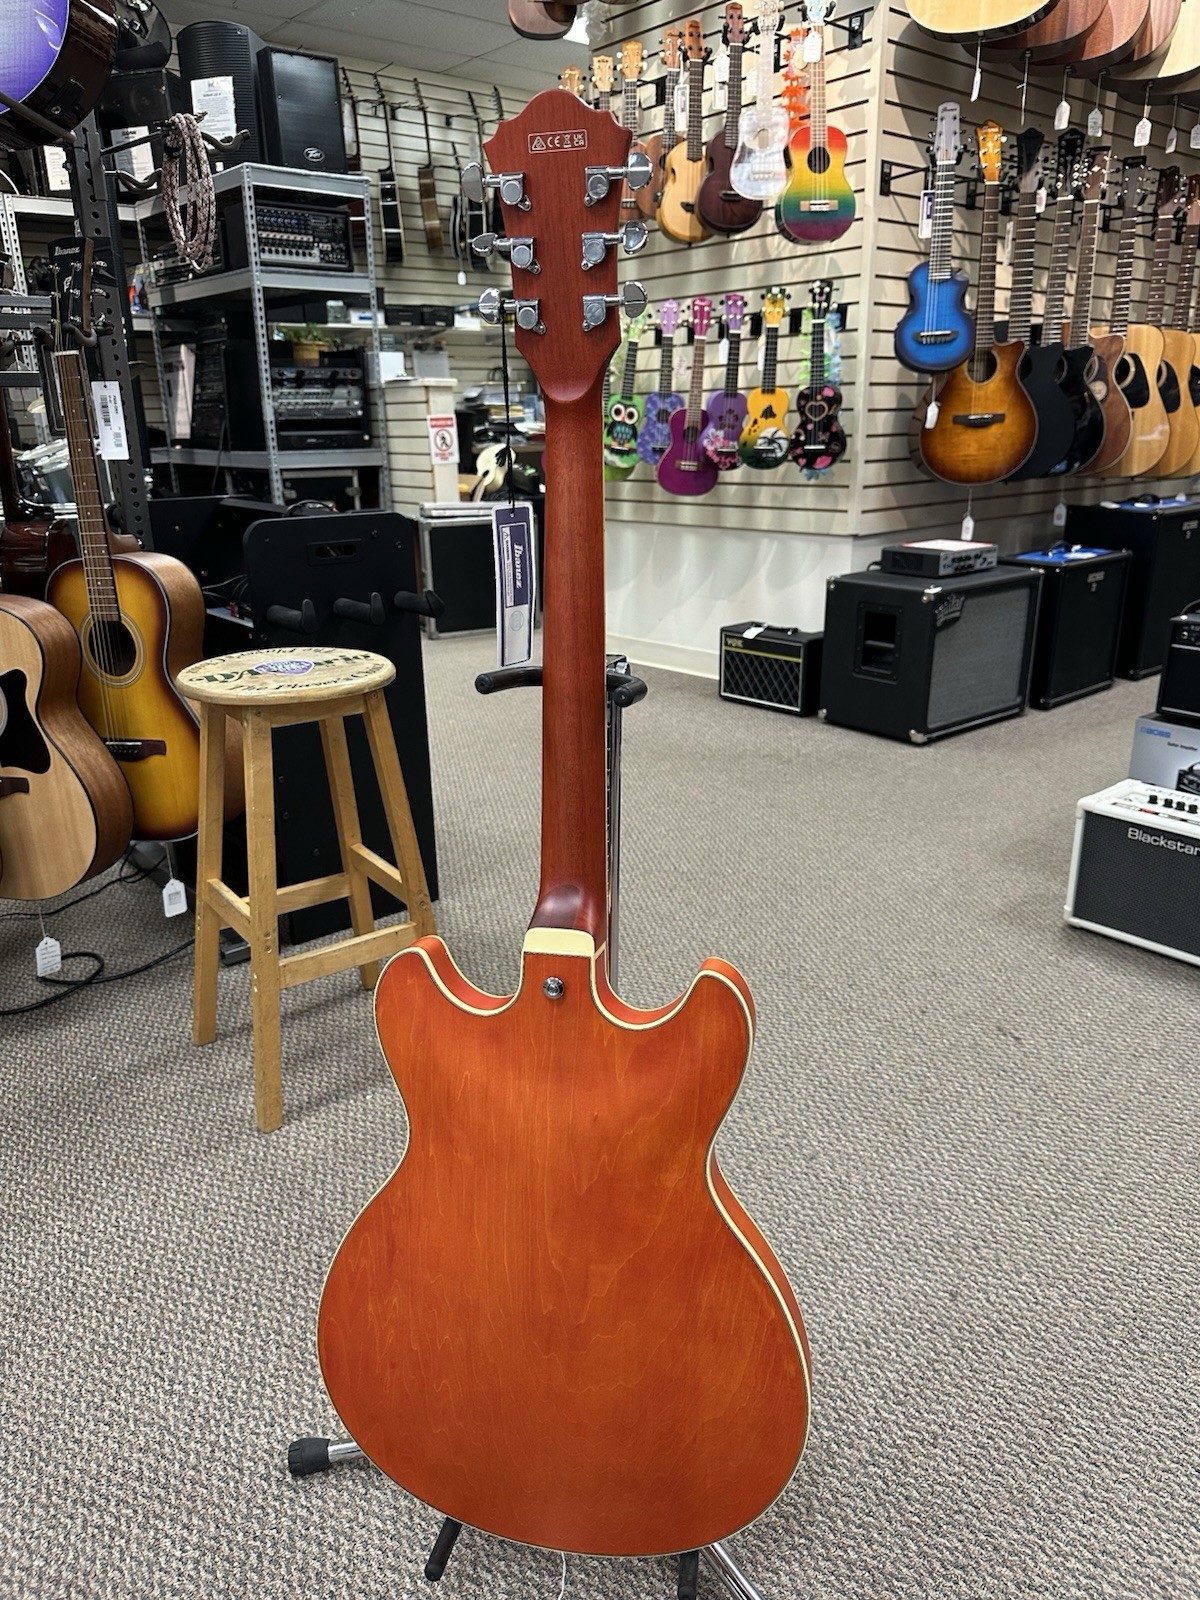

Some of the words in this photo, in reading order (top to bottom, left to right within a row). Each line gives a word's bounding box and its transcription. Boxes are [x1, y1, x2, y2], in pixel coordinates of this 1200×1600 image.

[547, 135, 560, 148] CE
[54, 246, 80, 256] Ibanez
[514, 543, 524, 589] Ibanez
[1128, 827, 1200, 856] Blackstar
